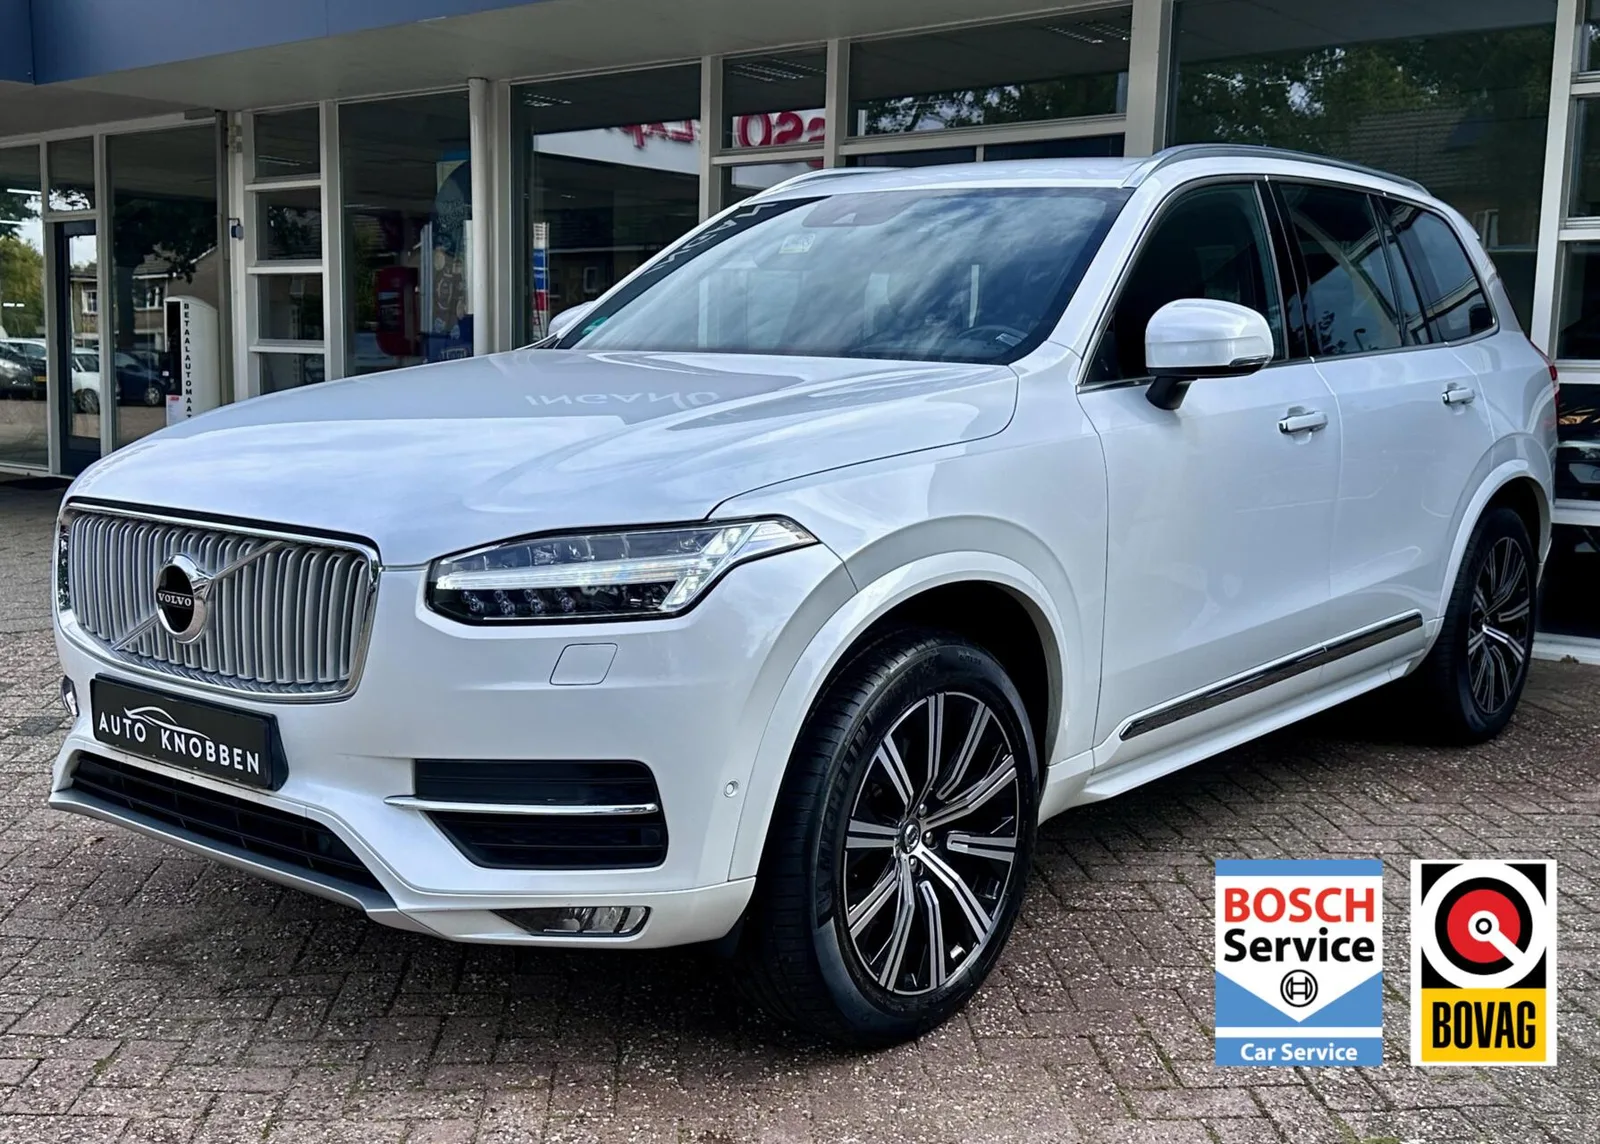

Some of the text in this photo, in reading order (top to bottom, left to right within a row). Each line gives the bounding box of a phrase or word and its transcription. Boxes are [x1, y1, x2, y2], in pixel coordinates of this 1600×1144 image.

[158, 592, 192, 607] VOLVO
[99, 711, 260, 775] AUTO KNOBBEN
